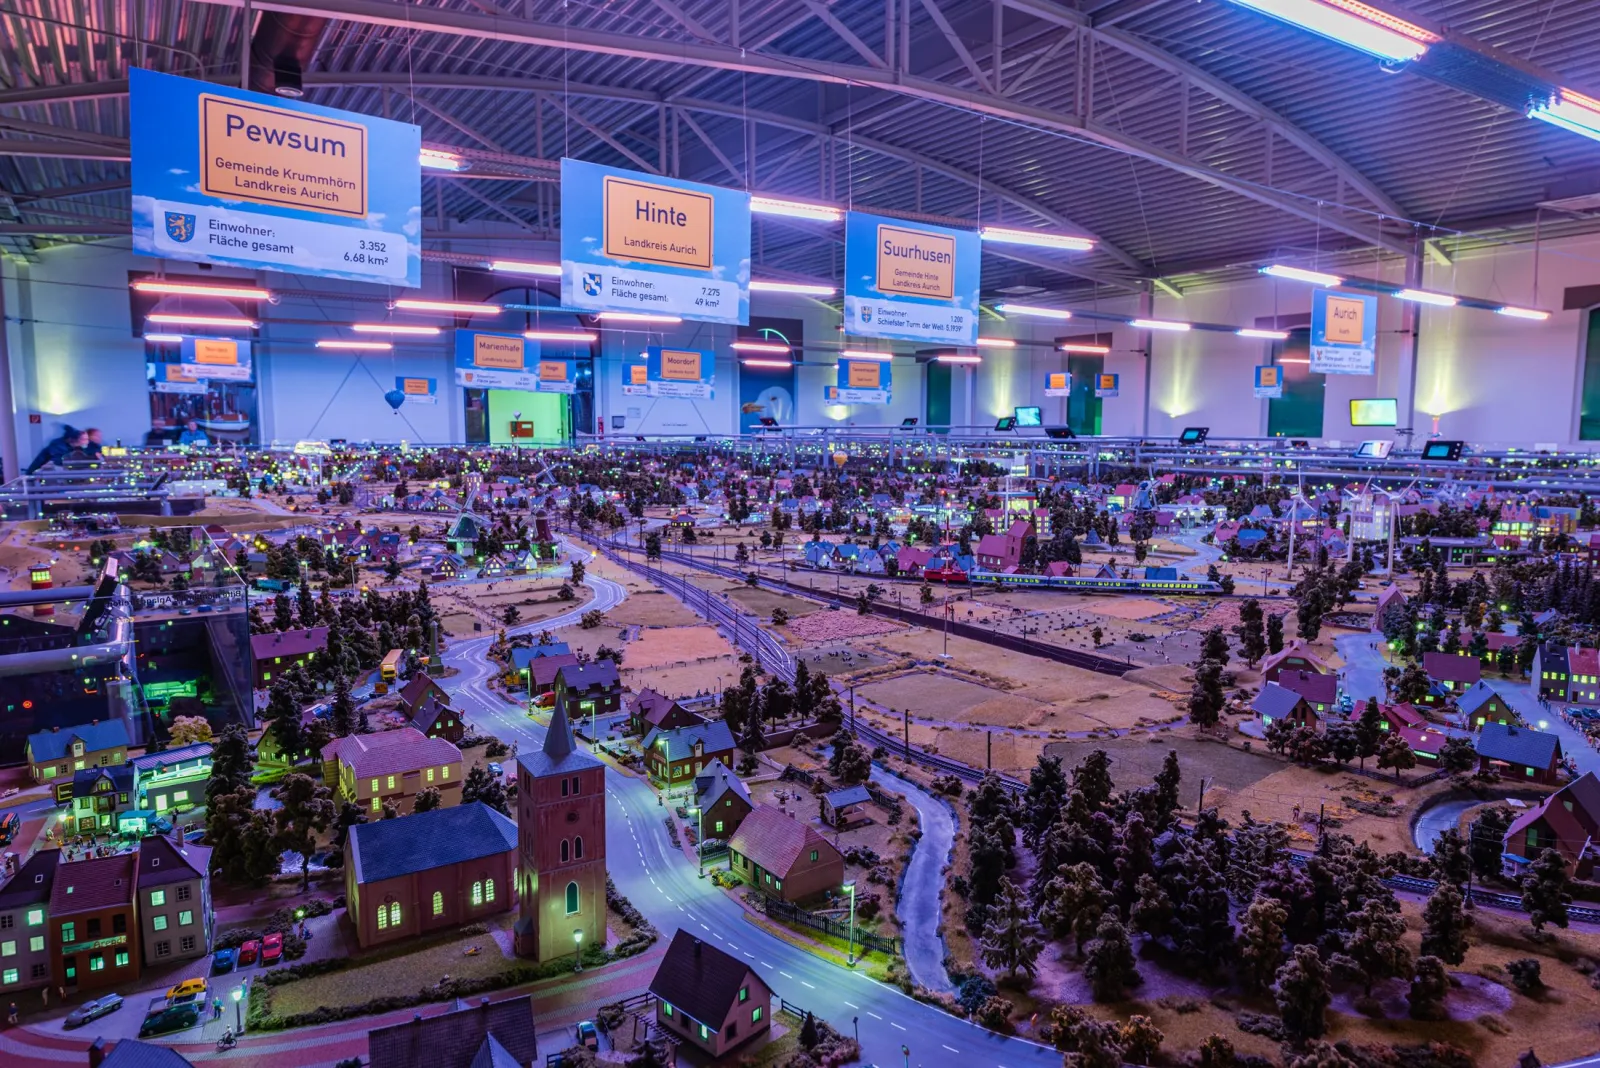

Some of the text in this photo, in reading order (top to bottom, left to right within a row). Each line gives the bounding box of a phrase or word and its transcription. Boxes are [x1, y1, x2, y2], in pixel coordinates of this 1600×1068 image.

[226, 113, 346, 158] Pewsum
[215, 157, 356, 190] Gemeinde Krummhörn
[234, 175, 339, 202] Landkreis Aurich
[636, 199, 687, 227] Hinte
[209, 218, 276, 238] Einwohner:
[209, 233, 294, 255] Fläche gesamt
[359, 239, 387, 253] 3.352
[624, 236, 697, 255] Landkreis Aurich
[343, 251, 389, 267] 6.68 km²
[884, 240, 951, 265] Suurhusen
[894, 268, 939, 281] Gemeinde Hinte
[893, 279, 940, 291] Landkreis Aurich
[611, 288, 637, 299] Fläche
[695, 298, 704, 306] 49
[1333, 307, 1357, 321] Aurich
[878, 317, 905, 327] Schiefster
[906, 320, 920, 329] Turm
[922, 322, 931, 330] der
[479, 342, 520, 352] Marienhafe
